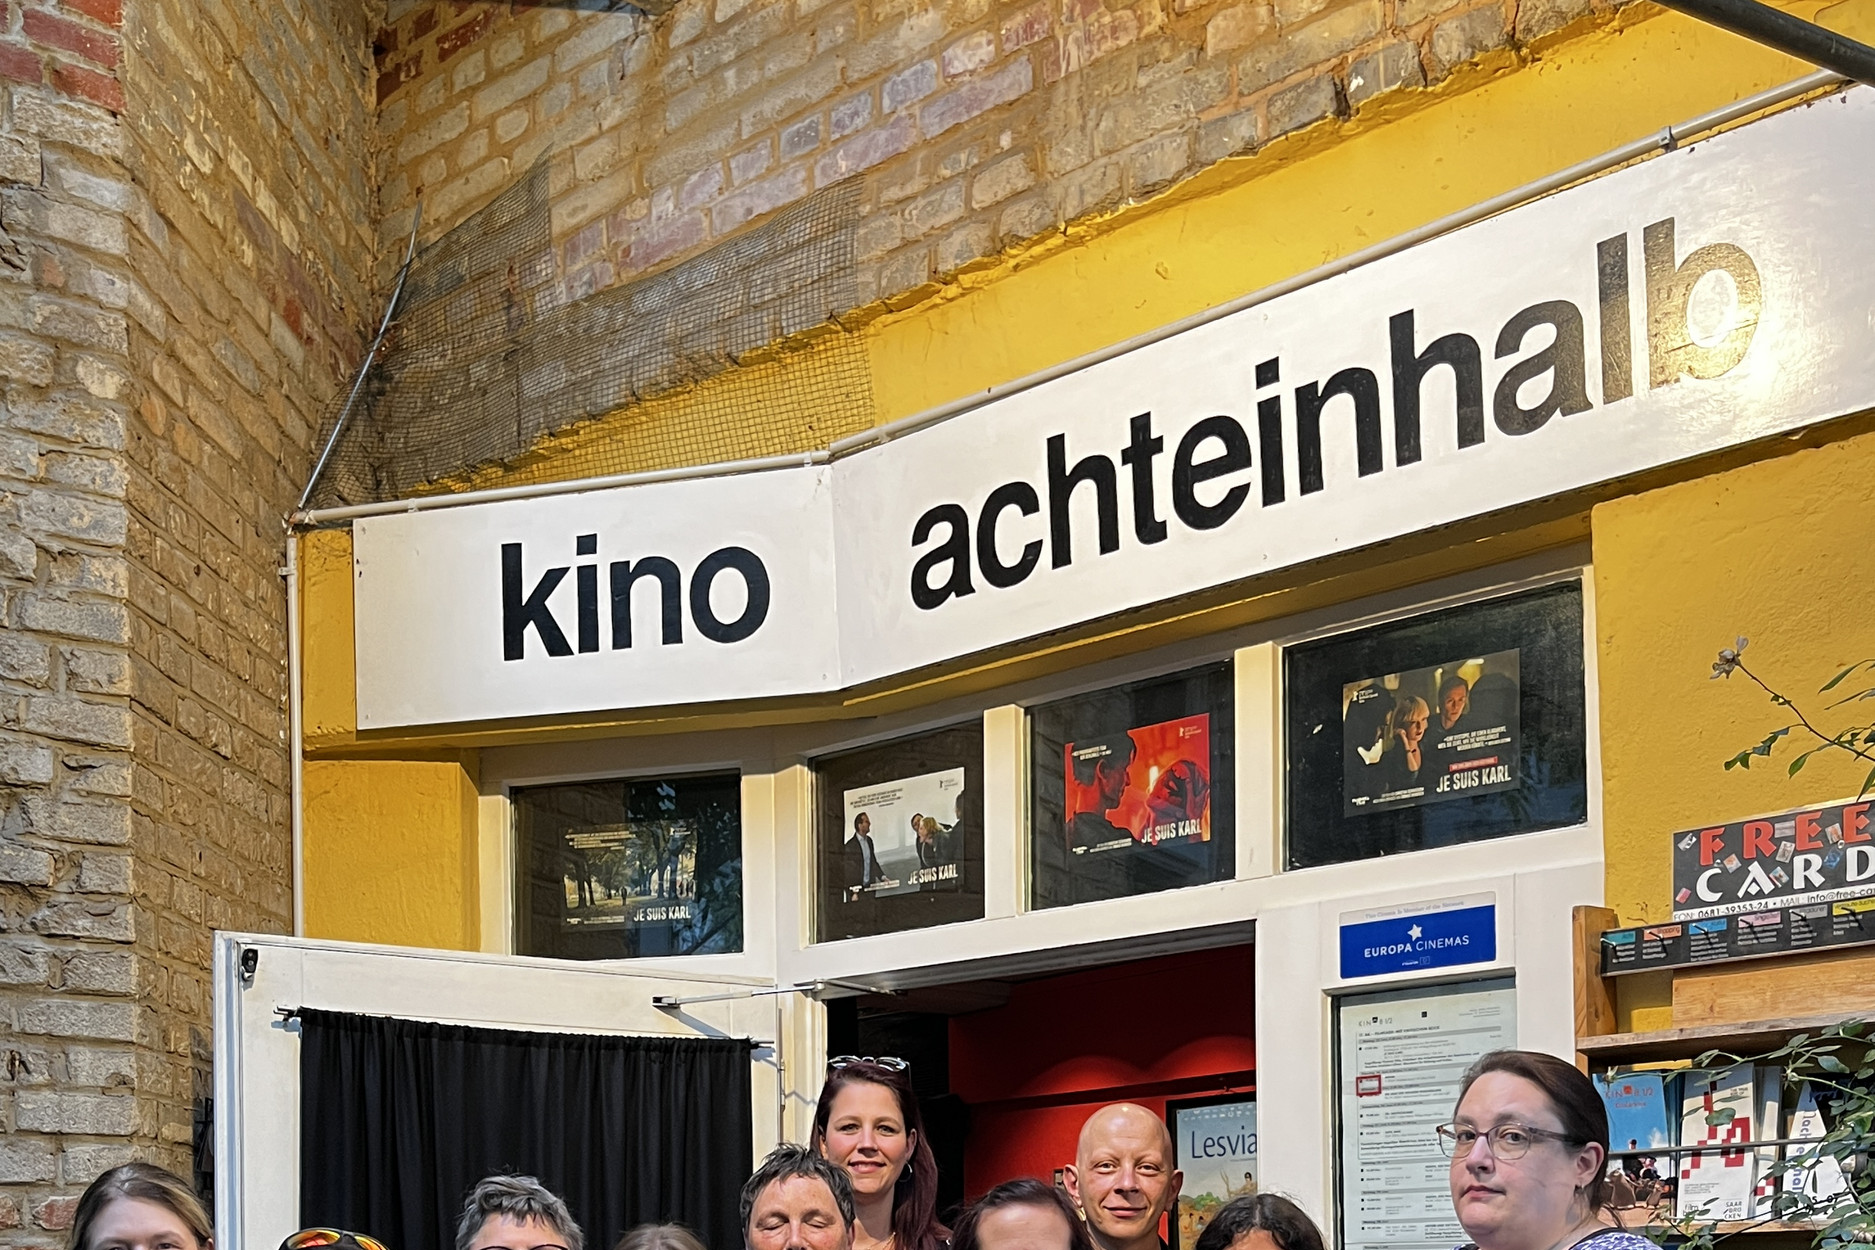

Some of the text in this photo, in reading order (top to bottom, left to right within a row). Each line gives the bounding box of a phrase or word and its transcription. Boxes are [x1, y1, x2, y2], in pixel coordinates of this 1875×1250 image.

[501, 216, 1764, 662] kino achteinhalb
[1436, 765, 1512, 793] JE SUIS KARL
[1141, 819, 1202, 843] JE SUIS KARL
[1699, 803, 1872, 866] FREE
[907, 864, 958, 885] JE SUIS KARL
[1696, 845, 1875, 903] CARD
[633, 909, 644, 922] JE
[646, 907, 667, 921] SUIS
[668, 906, 691, 920] KARL
[1364, 935, 1470, 958] EUROPA CINEMAS
[1192, 1126, 1257, 1158] Lesvia
